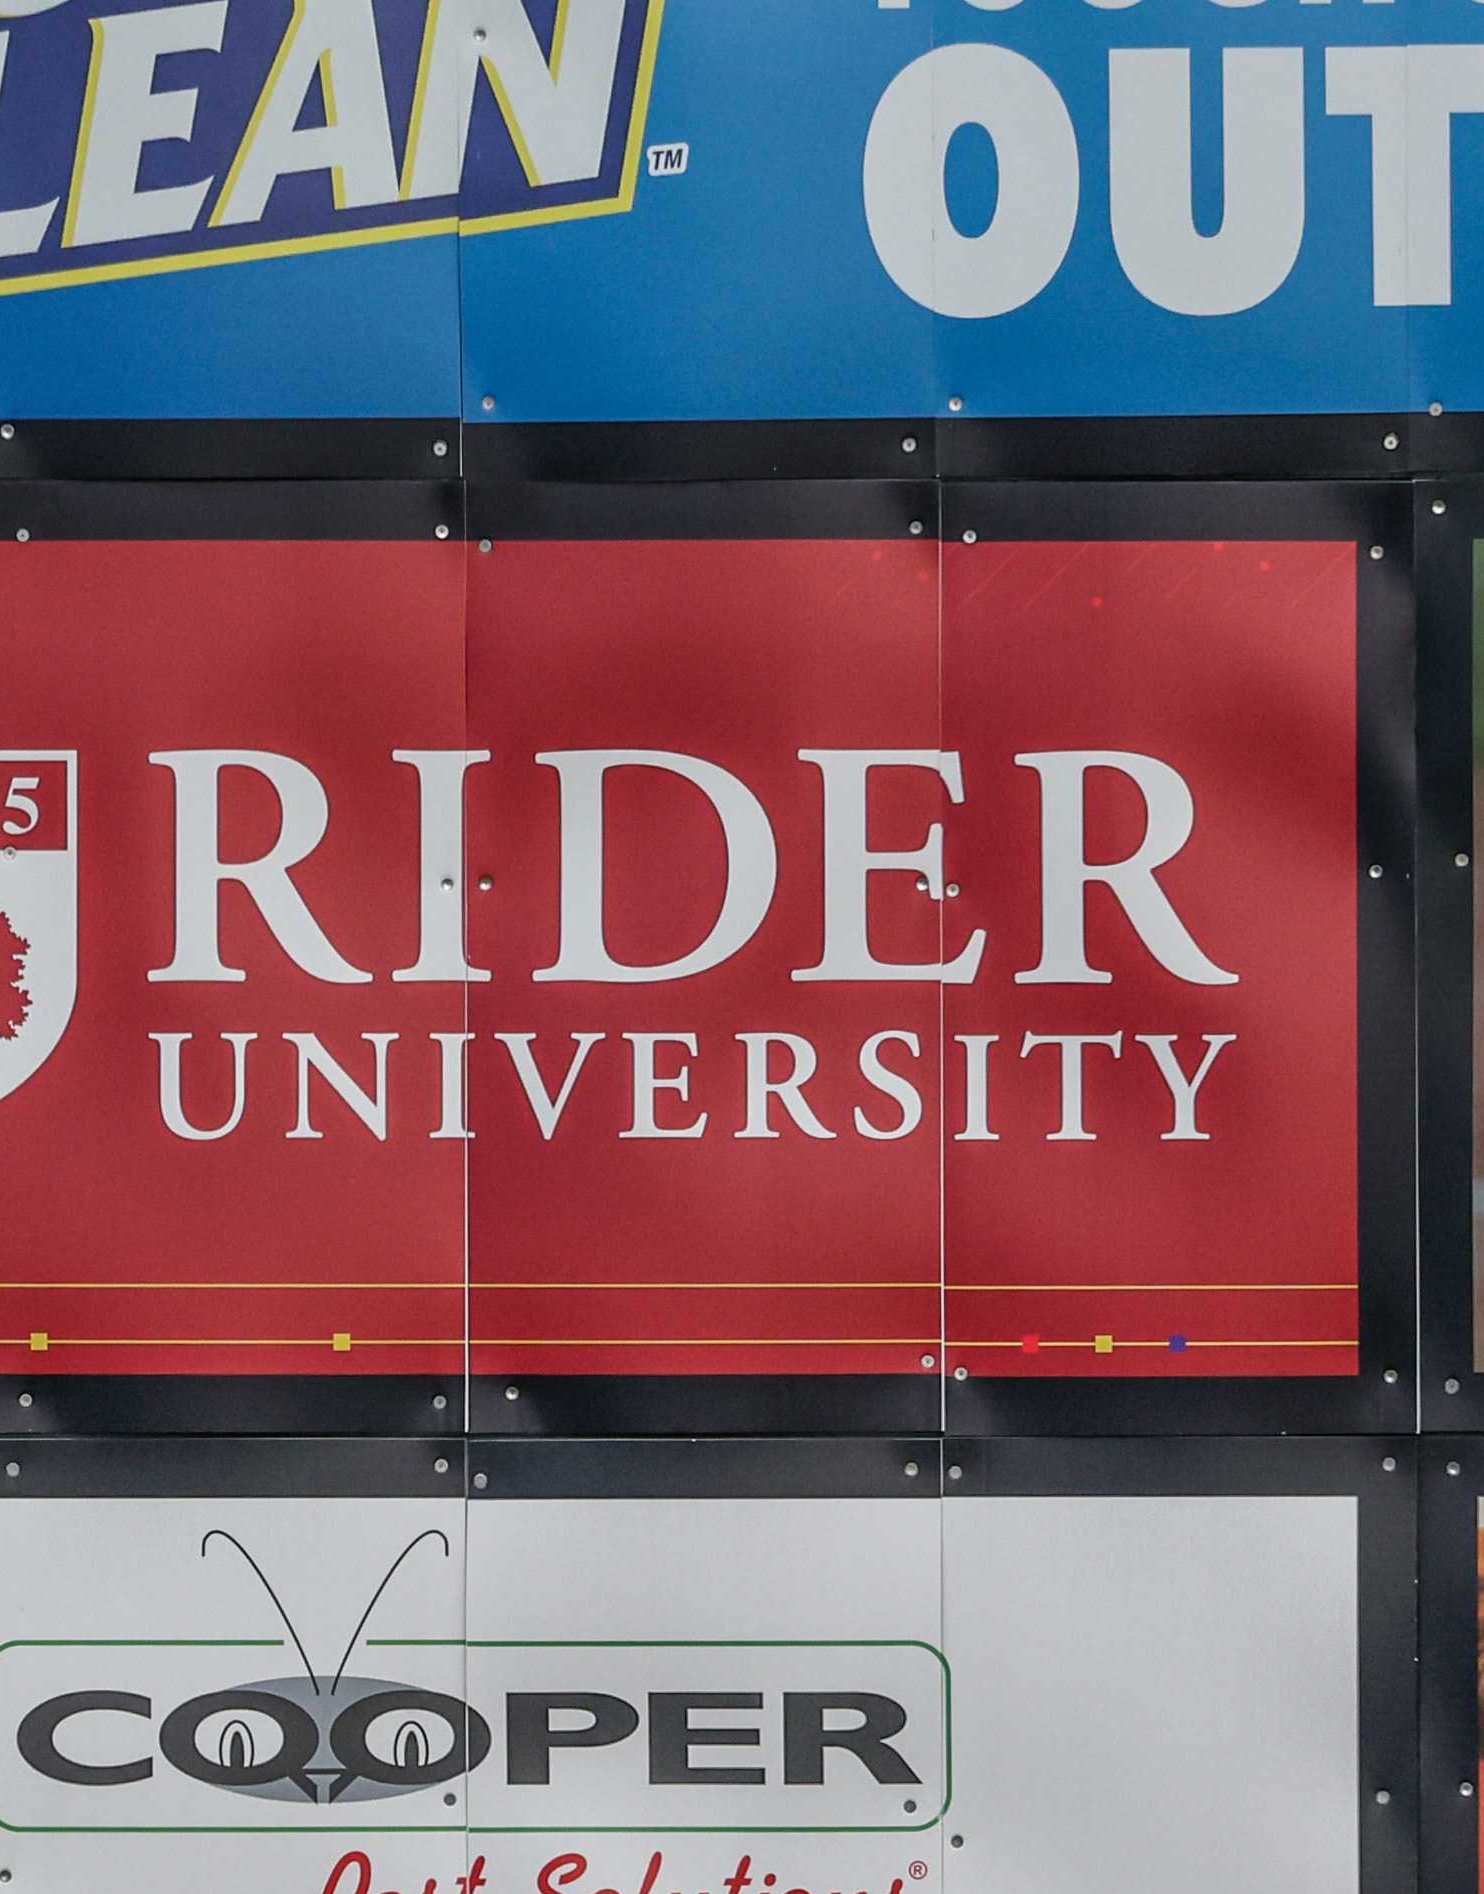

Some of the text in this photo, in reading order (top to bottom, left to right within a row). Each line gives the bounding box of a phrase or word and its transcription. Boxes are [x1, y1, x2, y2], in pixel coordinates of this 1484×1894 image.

[148, 748, 1239, 985] RIDER
[149, 1030, 1236, 1143] UNIVERSITY
[17, 1690, 923, 1789] COOPER
